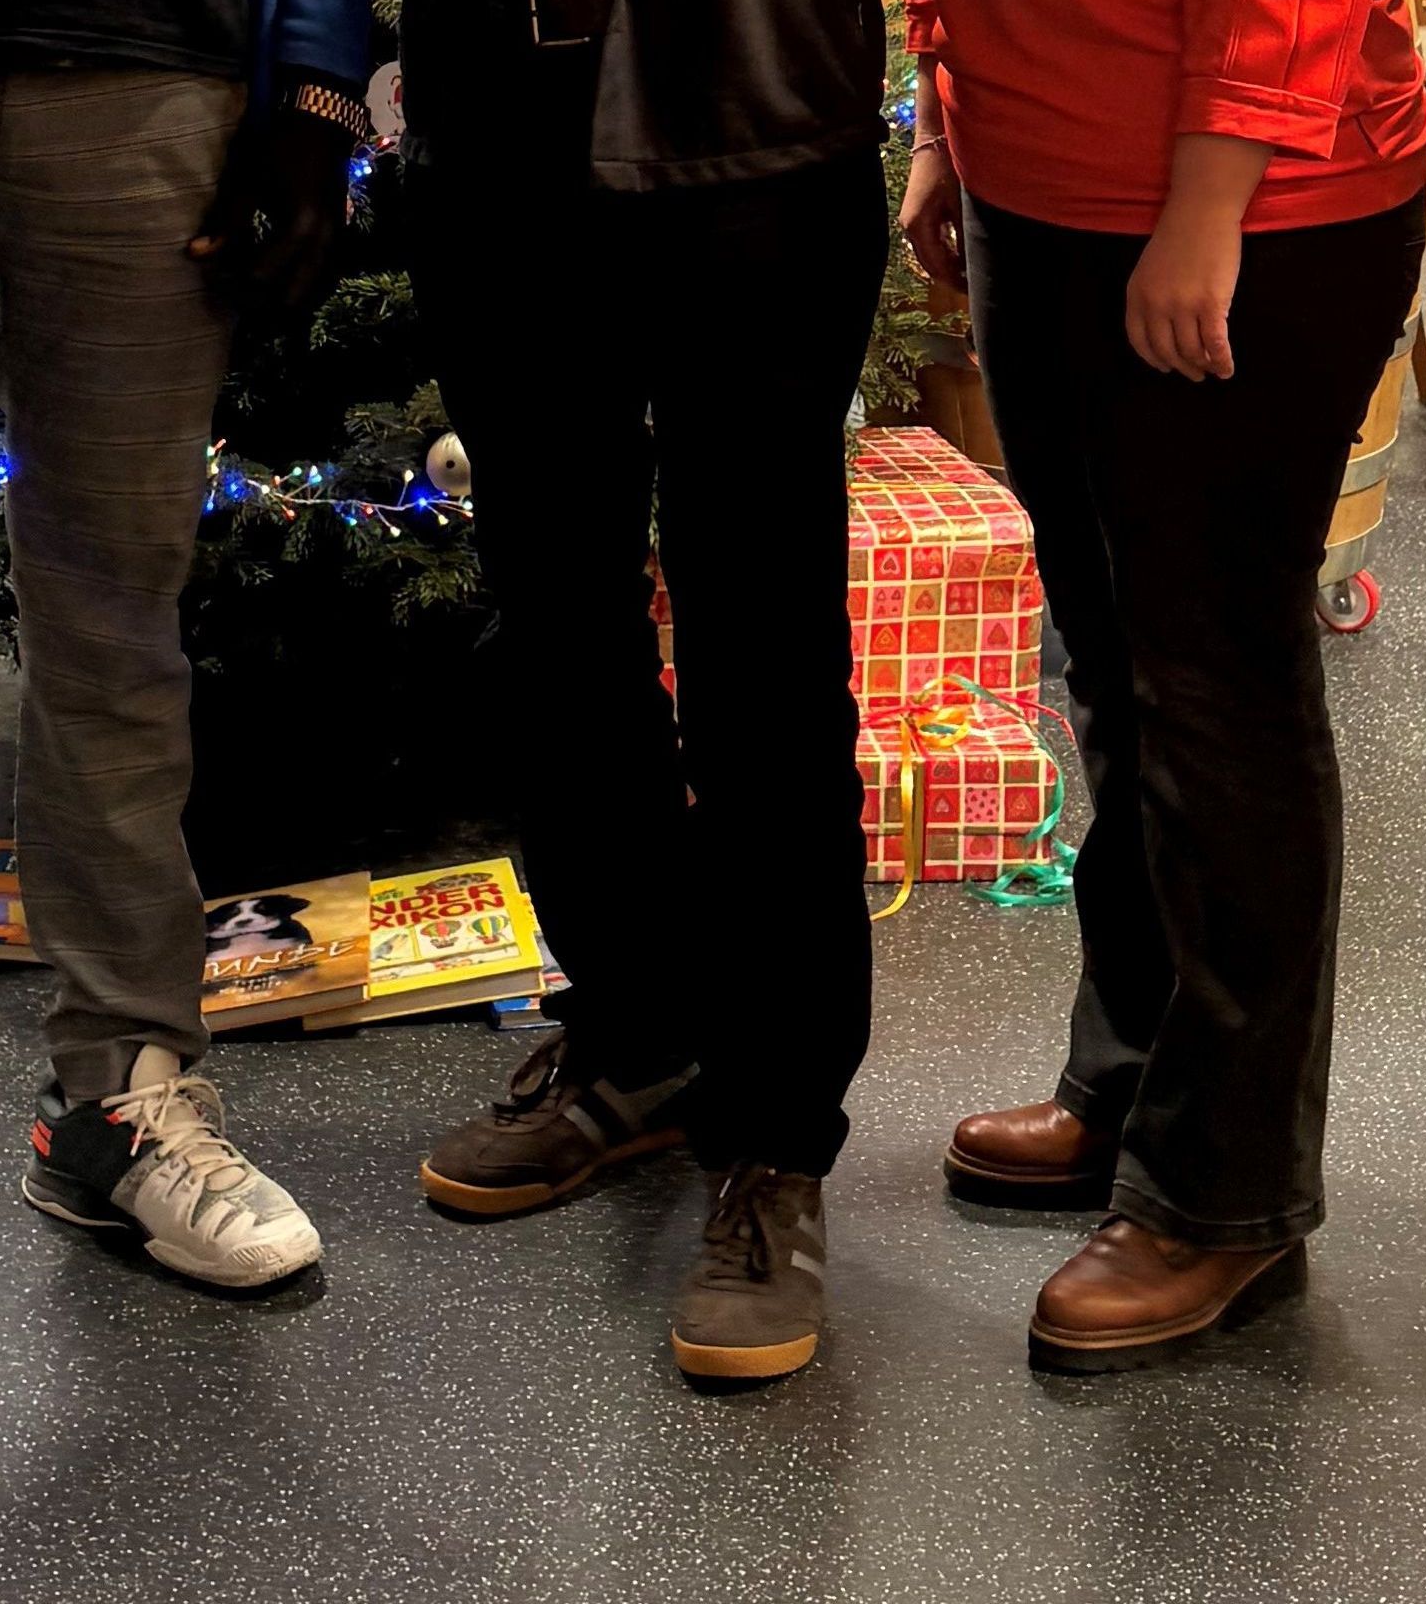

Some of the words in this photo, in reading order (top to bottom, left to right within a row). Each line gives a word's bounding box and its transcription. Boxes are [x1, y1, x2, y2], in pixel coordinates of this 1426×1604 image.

[370, 882, 504, 916] NDER
[370, 895, 506, 931] XIKON
[204, 939, 357, 978] UNDE
